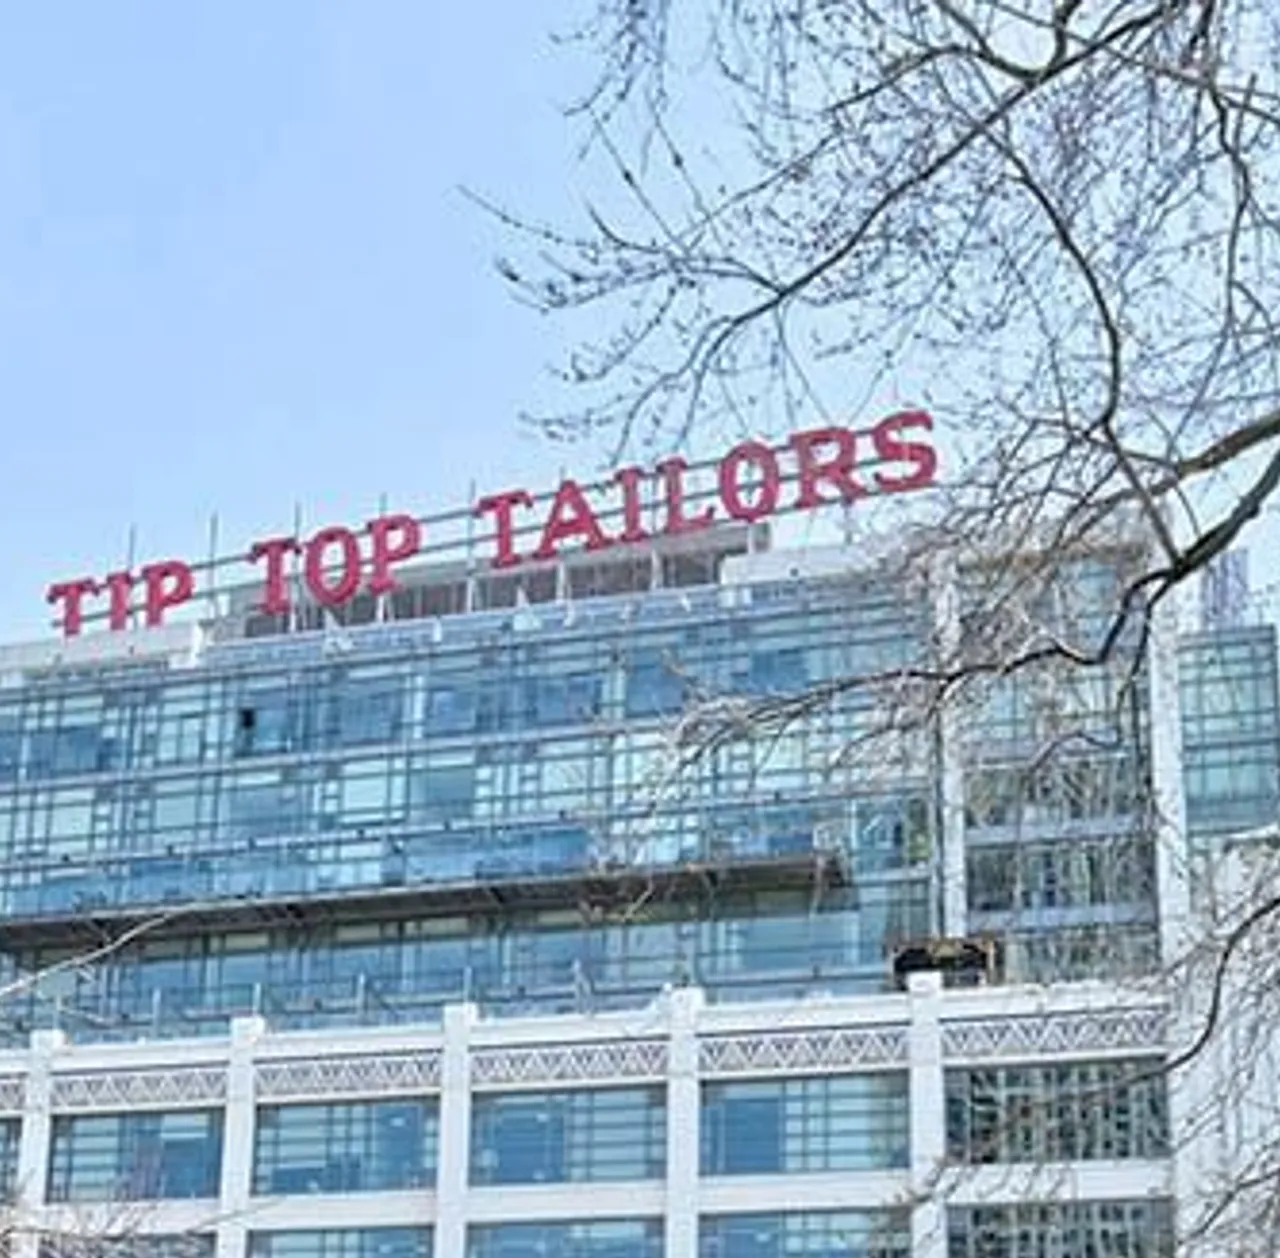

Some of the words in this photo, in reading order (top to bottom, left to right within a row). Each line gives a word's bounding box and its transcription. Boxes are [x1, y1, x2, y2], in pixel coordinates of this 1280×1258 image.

[48, 560, 195, 636] TIP
[247, 514, 422, 616] TOP
[473, 410, 938, 569] TAILORS
